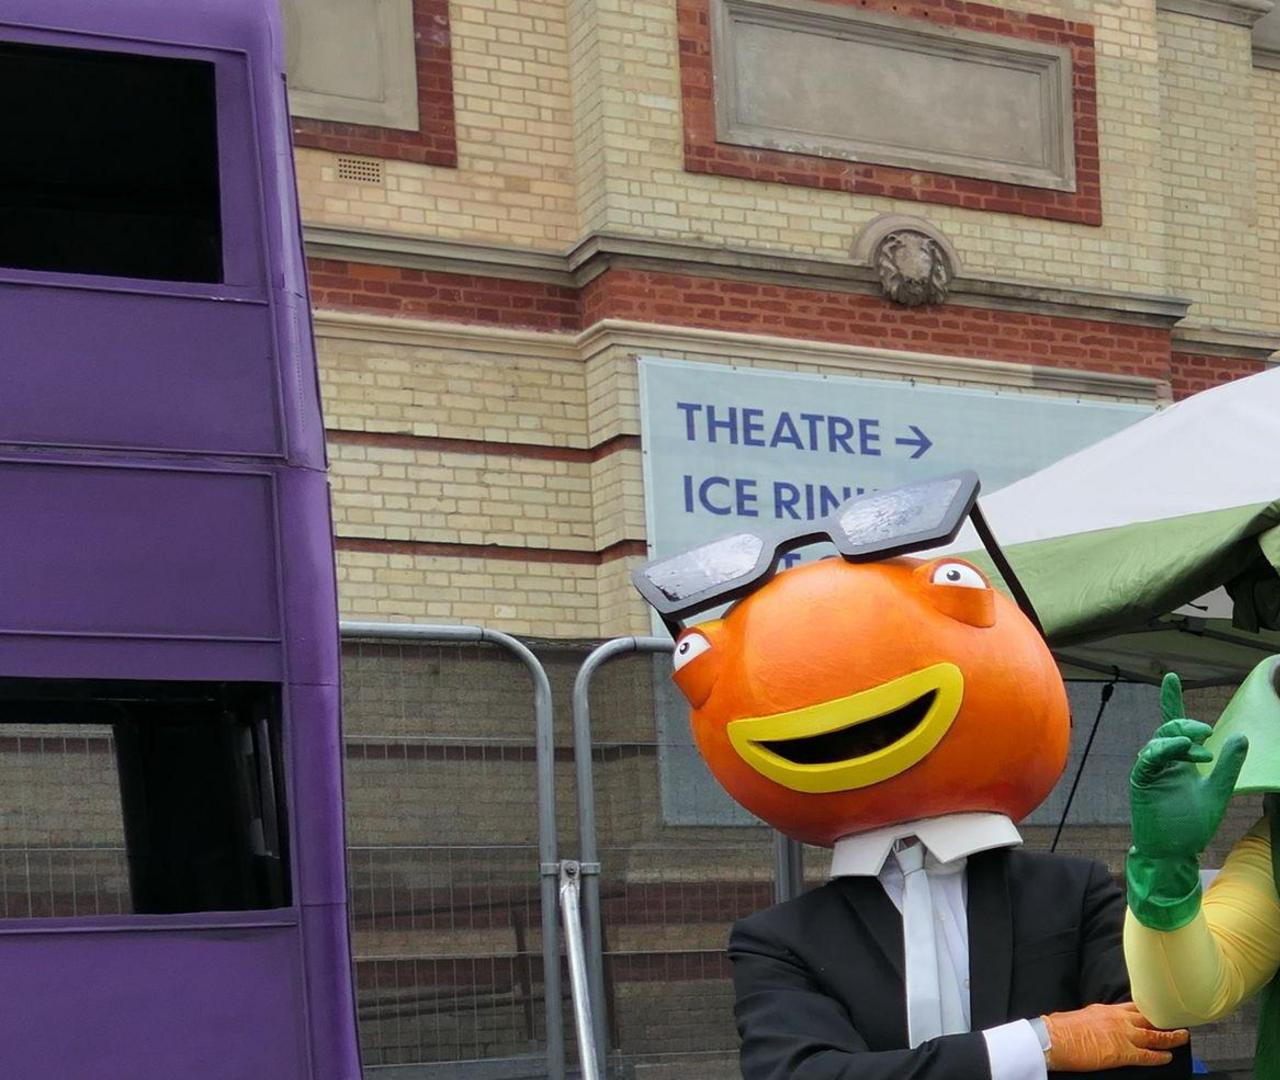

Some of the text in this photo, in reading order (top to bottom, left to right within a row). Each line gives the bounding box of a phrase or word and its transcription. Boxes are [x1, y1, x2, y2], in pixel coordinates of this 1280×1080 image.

[676, 401, 882, 457] THEATRE
[683, 474, 879, 521] ICE RIN
